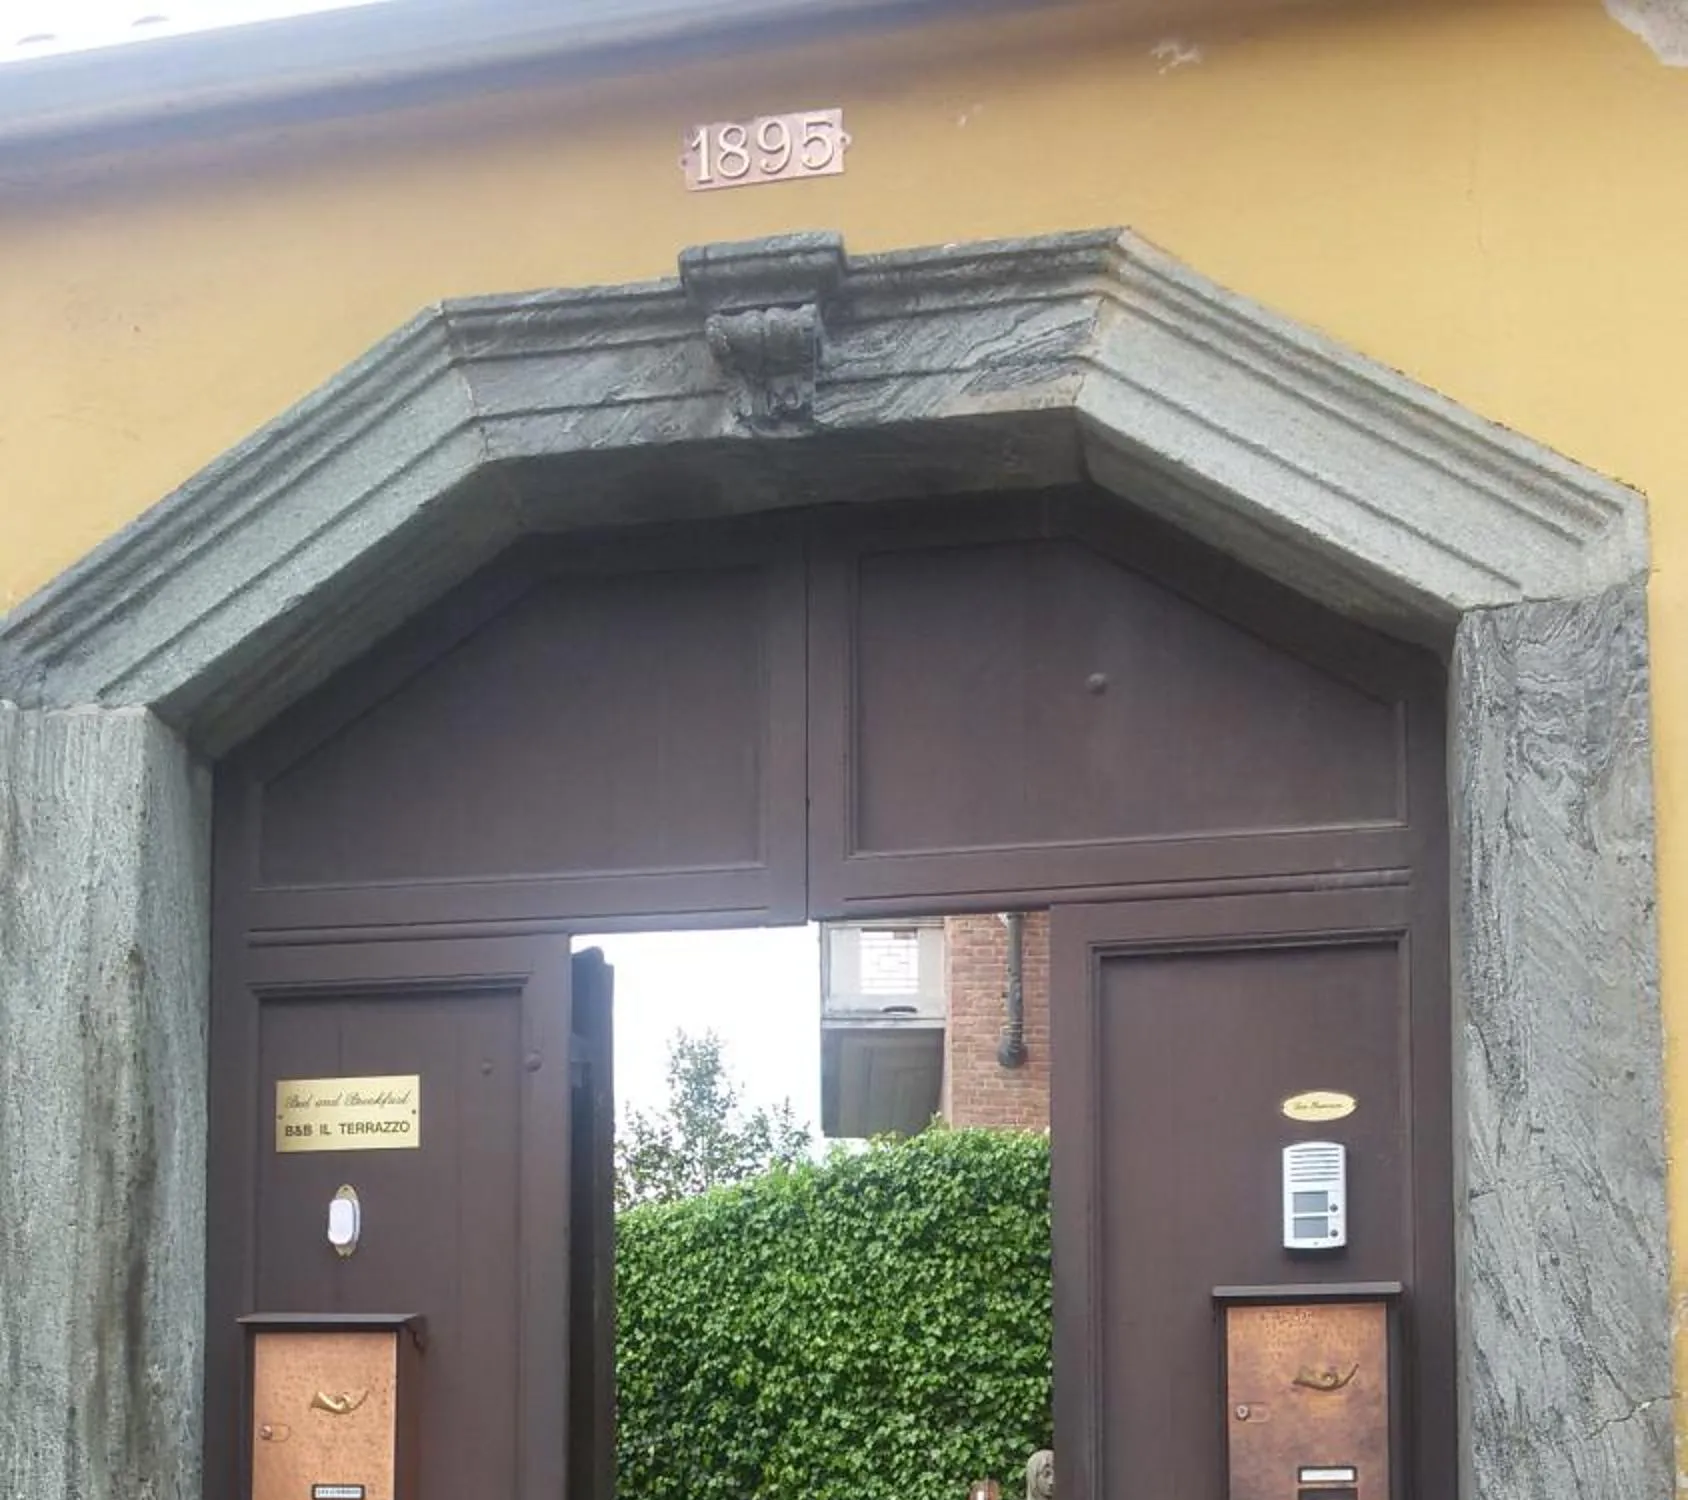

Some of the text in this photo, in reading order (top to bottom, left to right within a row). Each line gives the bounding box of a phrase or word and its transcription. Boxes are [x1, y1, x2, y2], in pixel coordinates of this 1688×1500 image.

[691, 116, 836, 185] 1895
[285, 1120, 411, 1137] B&B IL TERRAZZO
